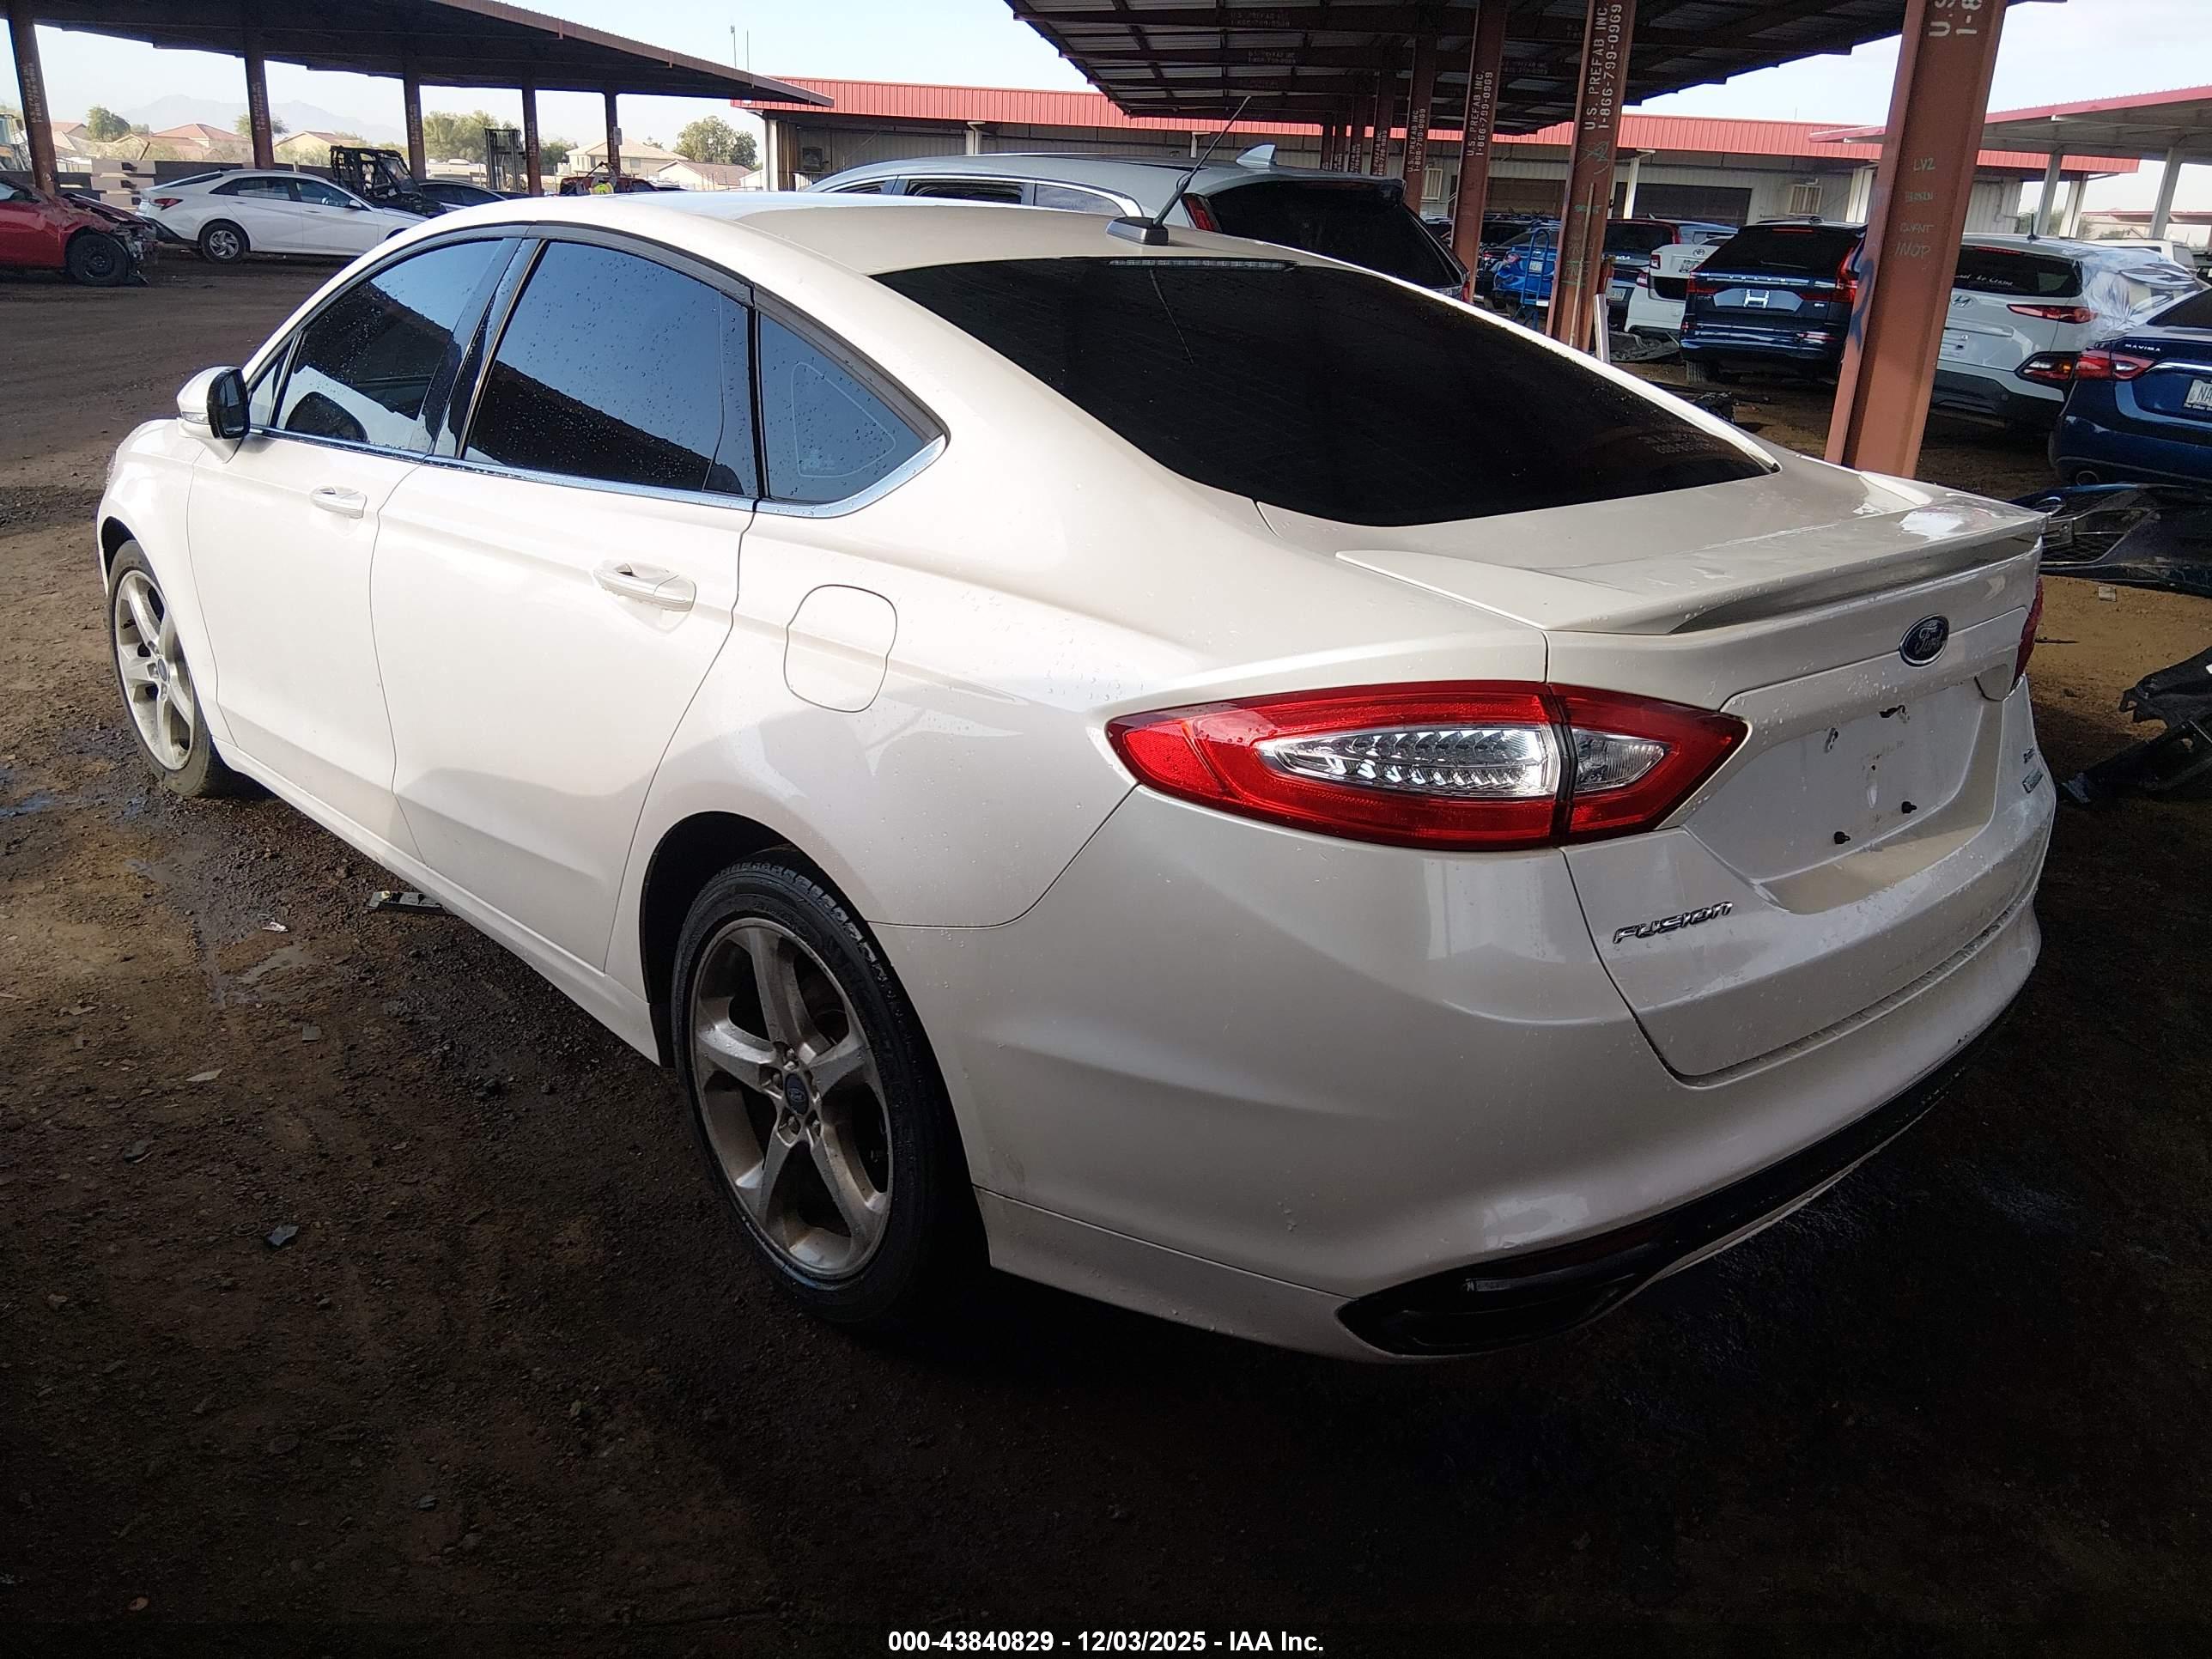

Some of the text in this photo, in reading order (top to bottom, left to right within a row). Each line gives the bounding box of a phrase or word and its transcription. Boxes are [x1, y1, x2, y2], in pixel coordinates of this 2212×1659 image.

[1584, 3, 1610, 131] U.S. PREFAB INC.
[1598, 3, 1622, 129] 1-866-799-0969
[1467, 137, 1477, 156] U.S.
[1469, 94, 1481, 132] PREFAB
